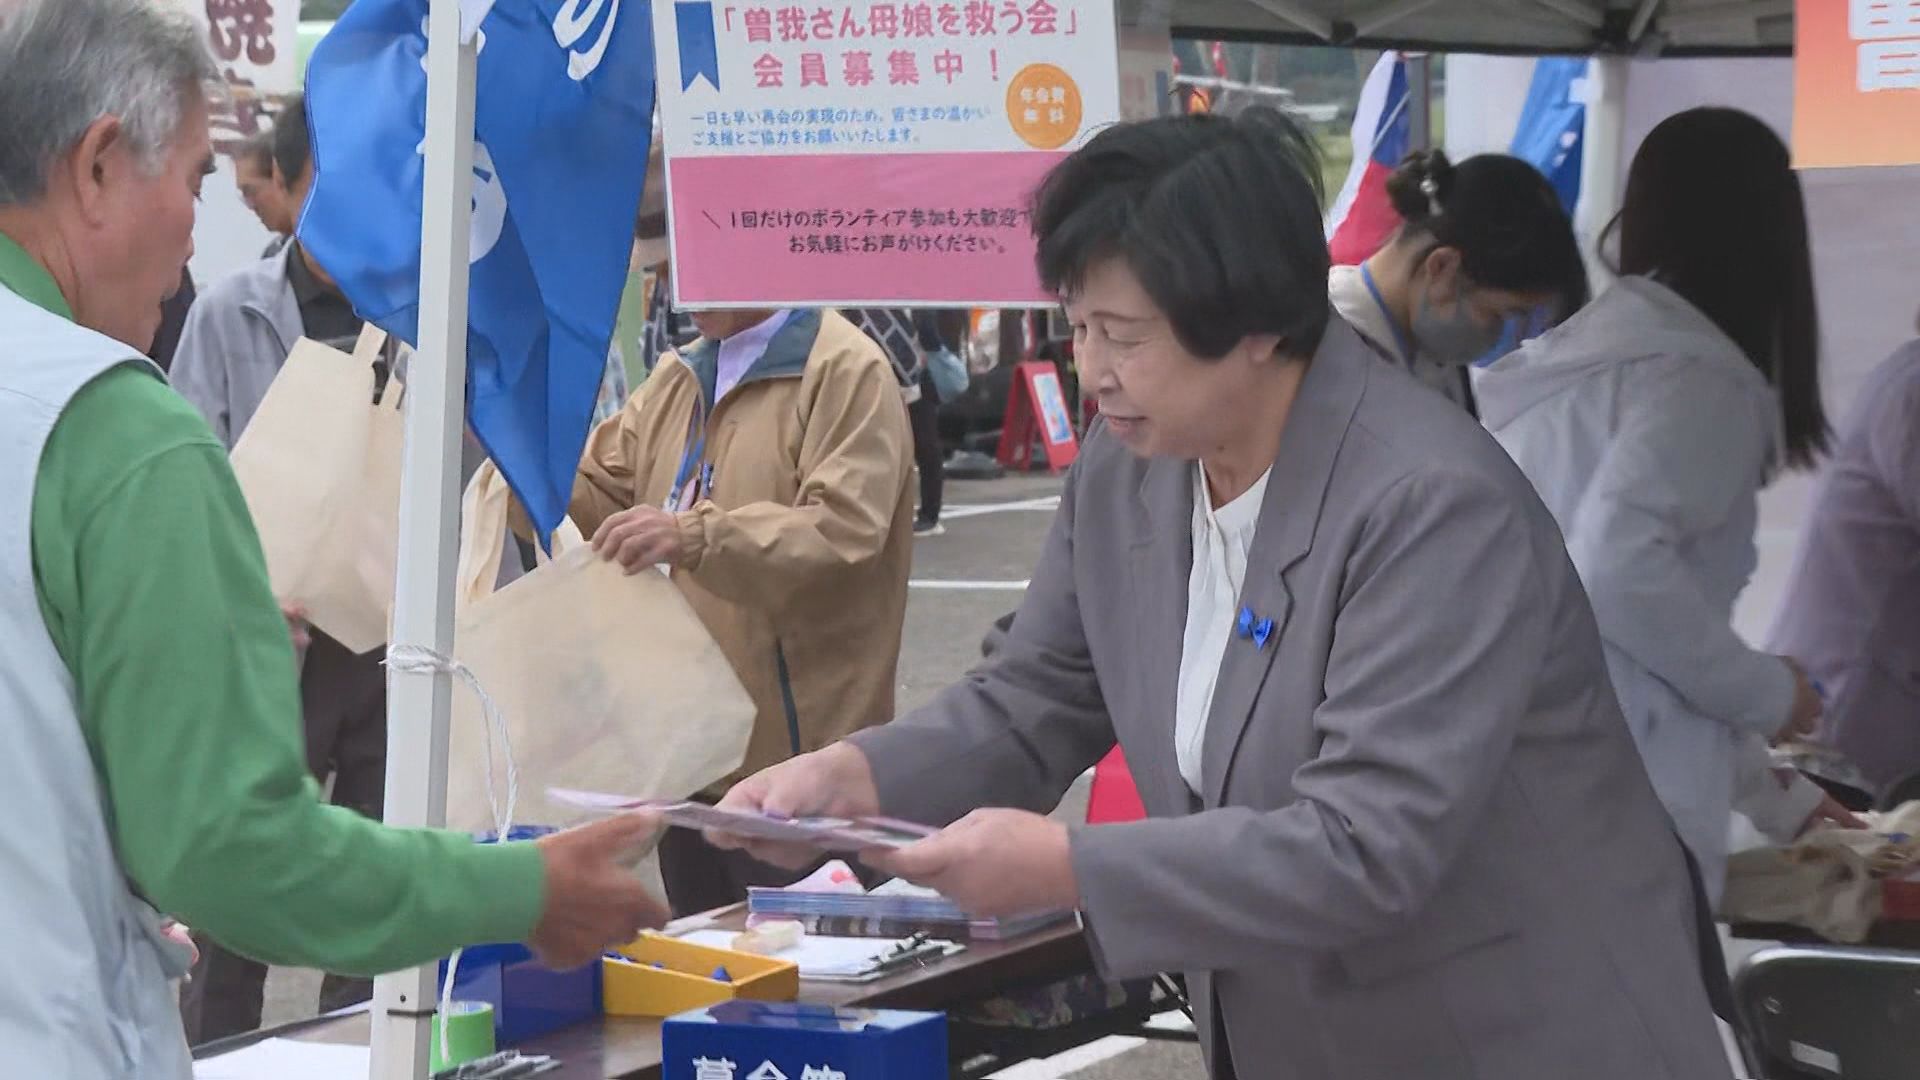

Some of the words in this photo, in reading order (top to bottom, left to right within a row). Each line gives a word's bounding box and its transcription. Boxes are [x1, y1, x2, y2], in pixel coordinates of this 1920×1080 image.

[724, 0, 1077, 43] 「曽我さん母娘を救う会」
[753, 48, 998, 88] 会員募集中！
[789, 234, 1006, 254] お気軽にお声がけください。
